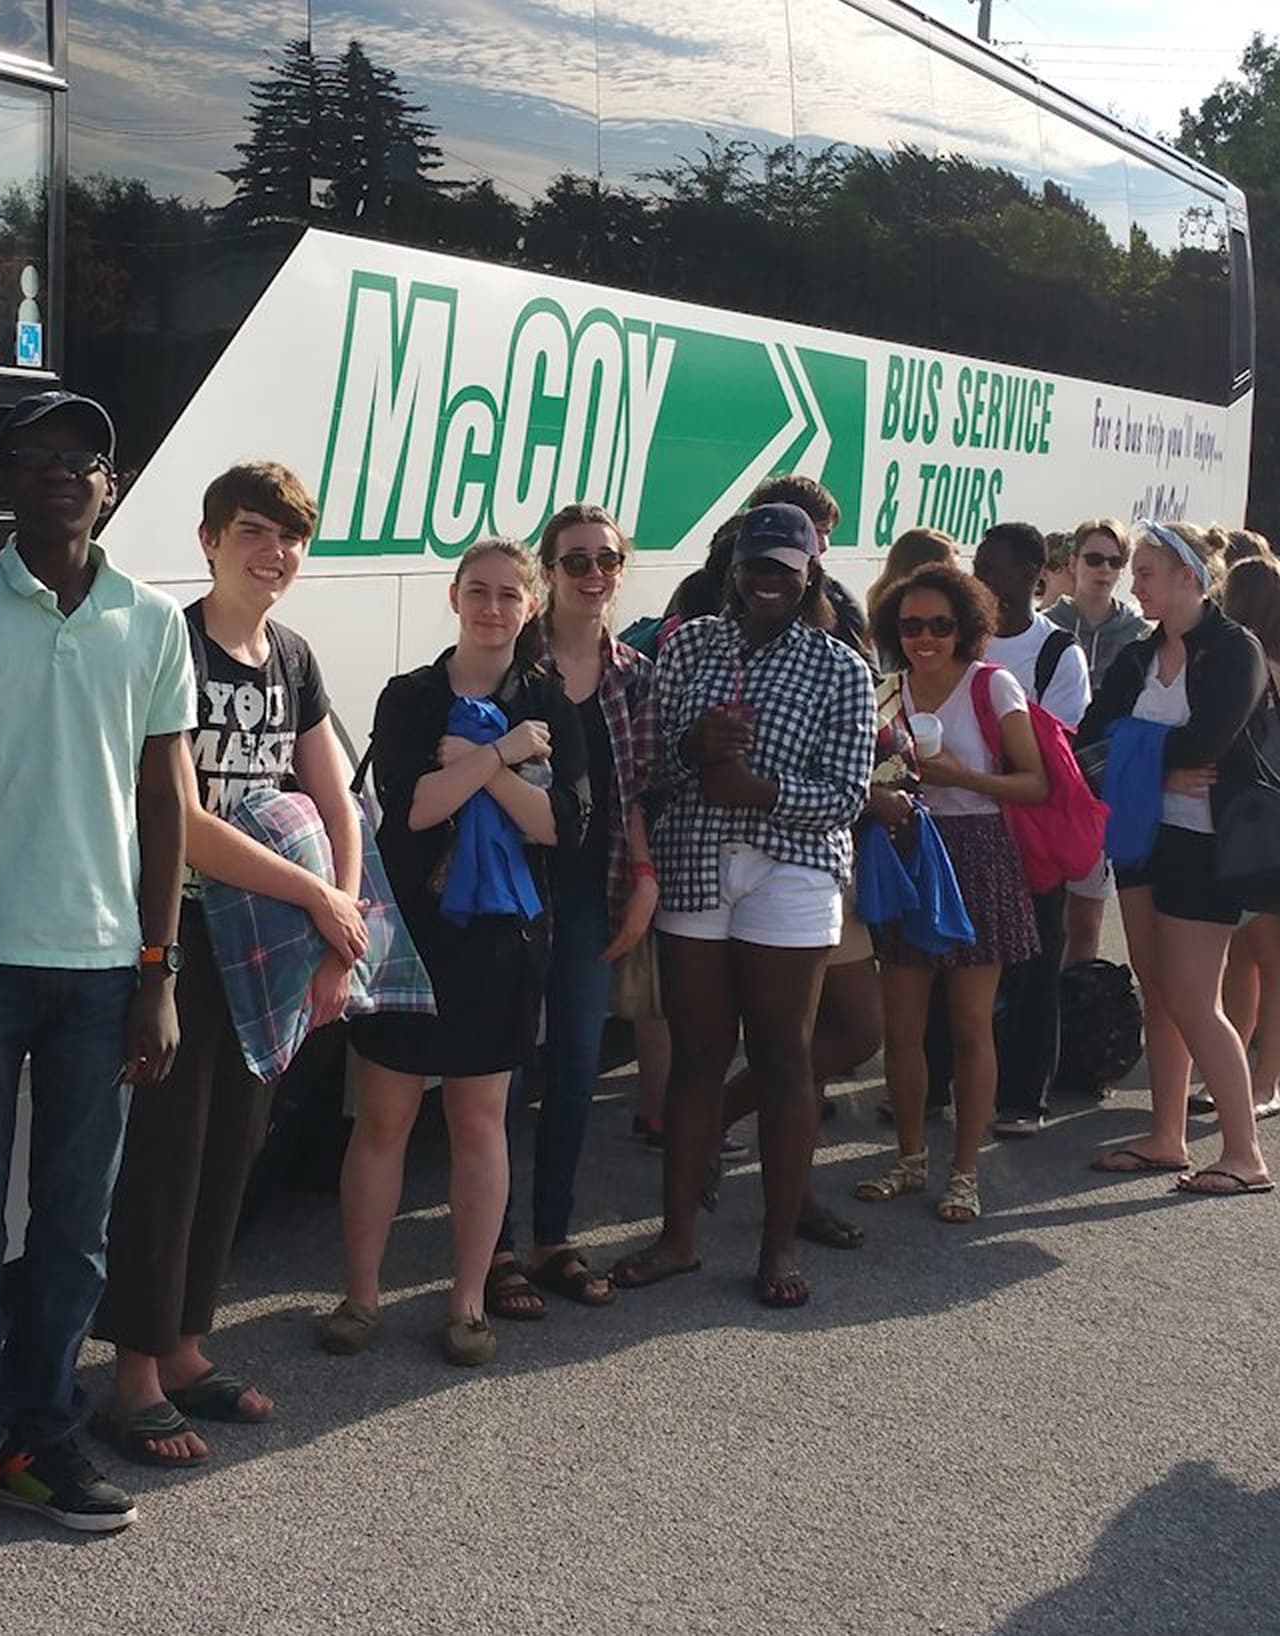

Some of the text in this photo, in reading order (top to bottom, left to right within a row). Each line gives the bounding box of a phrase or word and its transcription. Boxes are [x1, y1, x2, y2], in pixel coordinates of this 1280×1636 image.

[880, 354, 1056, 454] BUS SERVICE
[1092, 397, 1112, 449] For
[1114, 415, 1121, 451] a
[1125, 402, 1143, 454] bus
[1145, 412, 1164, 469] trip
[874, 460, 1004, 548] & TOURS
[205, 680, 286, 731] YOU
[205, 777, 276, 819] M
